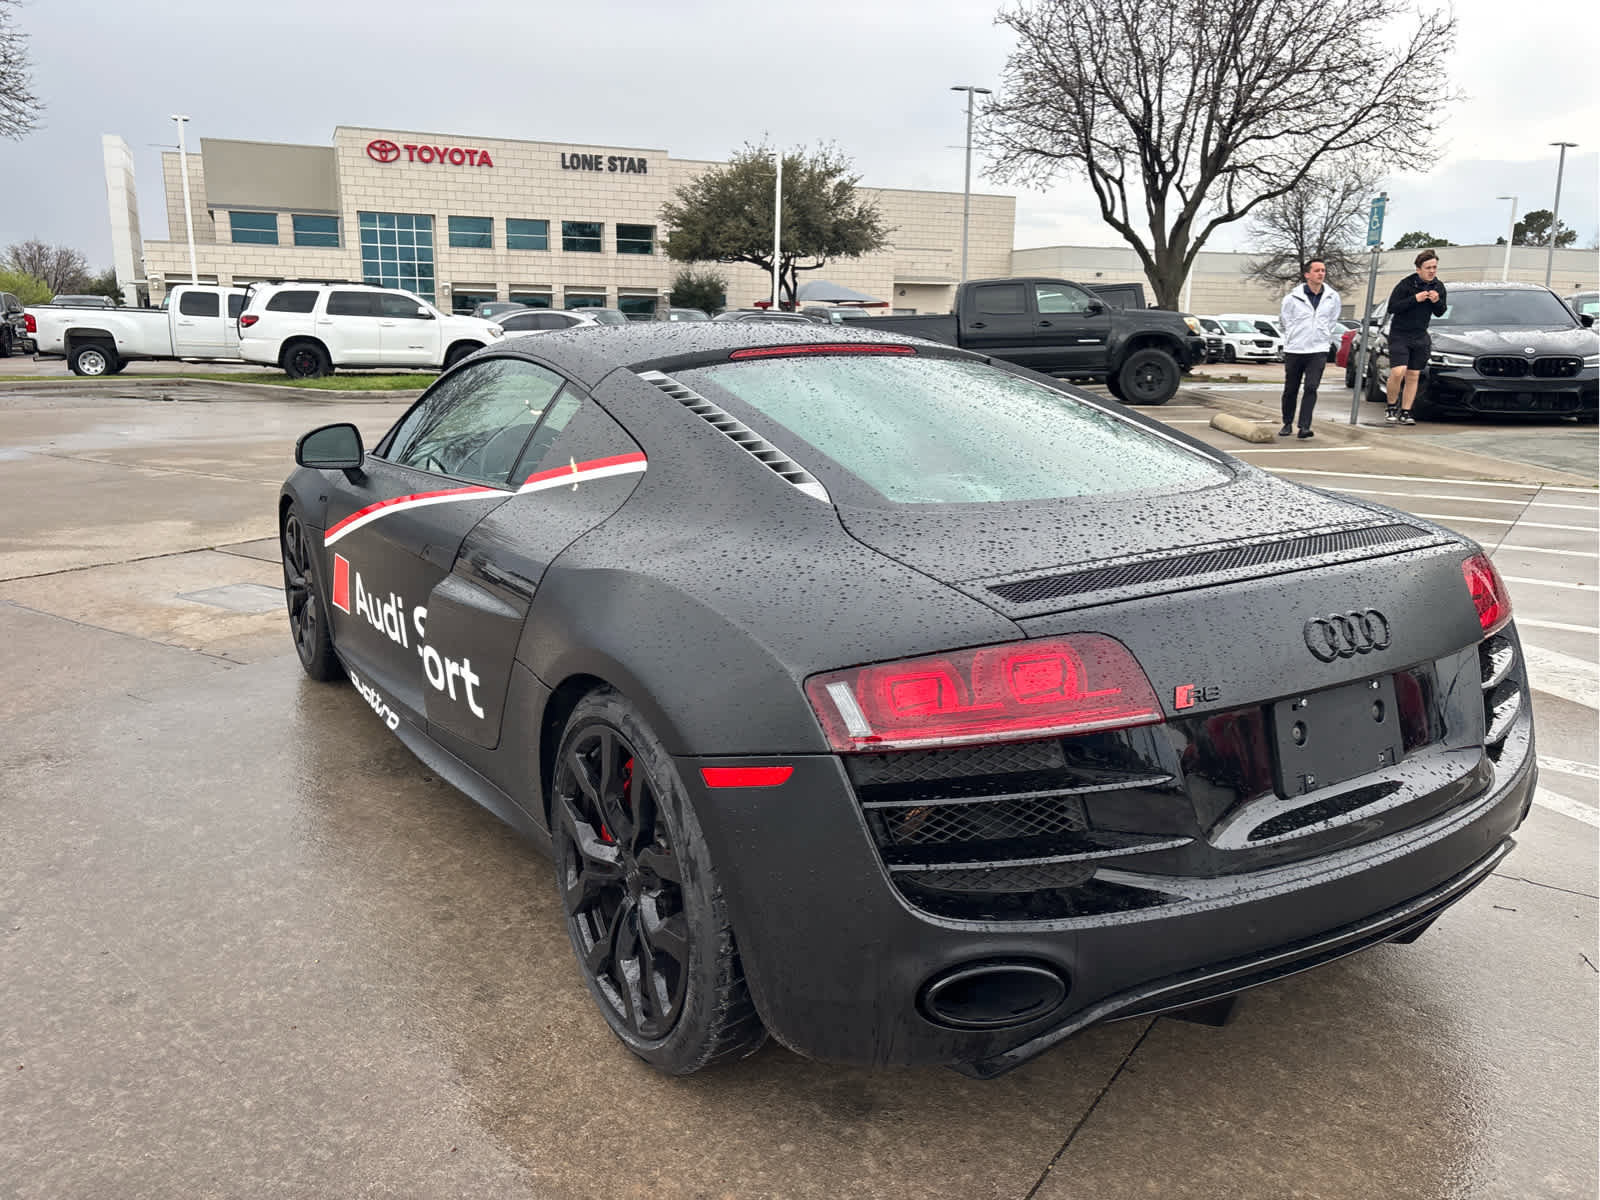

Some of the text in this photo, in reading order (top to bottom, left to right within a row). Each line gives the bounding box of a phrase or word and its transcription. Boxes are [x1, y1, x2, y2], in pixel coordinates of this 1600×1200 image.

[403, 143, 493, 168] TOYOTA
[561, 152, 648, 174] LONE STAR
[355, 571, 485, 719] Audi Sort
